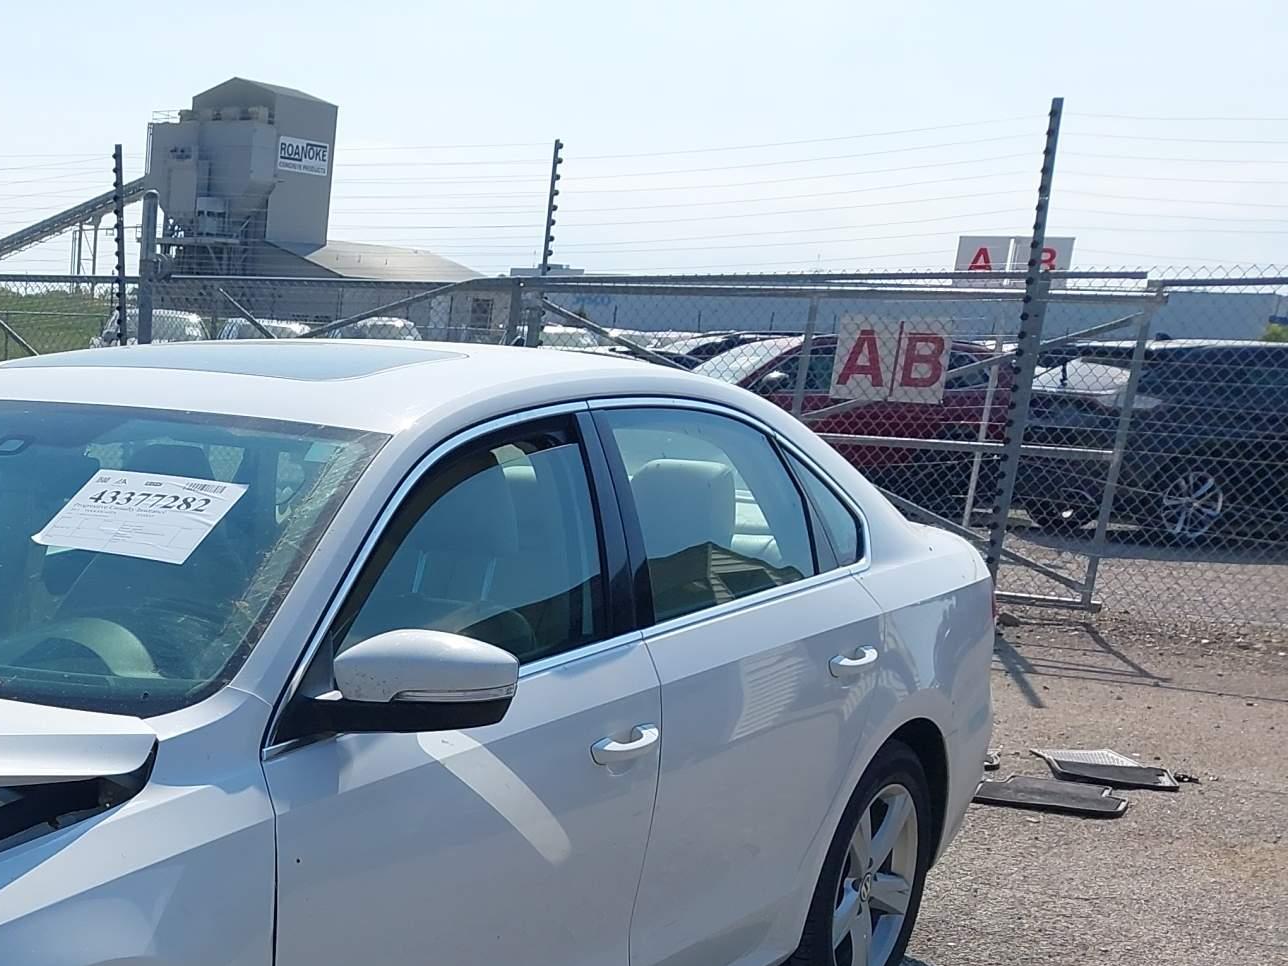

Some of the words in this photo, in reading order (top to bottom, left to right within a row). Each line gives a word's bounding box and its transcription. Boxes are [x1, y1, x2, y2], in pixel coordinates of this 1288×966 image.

[280, 142, 328, 162] ROANOKE
[968, 247, 992, 271] A
[836, 328, 884, 388] A
[900, 332, 945, 388] B
[88, 489, 212, 513] 43377282
